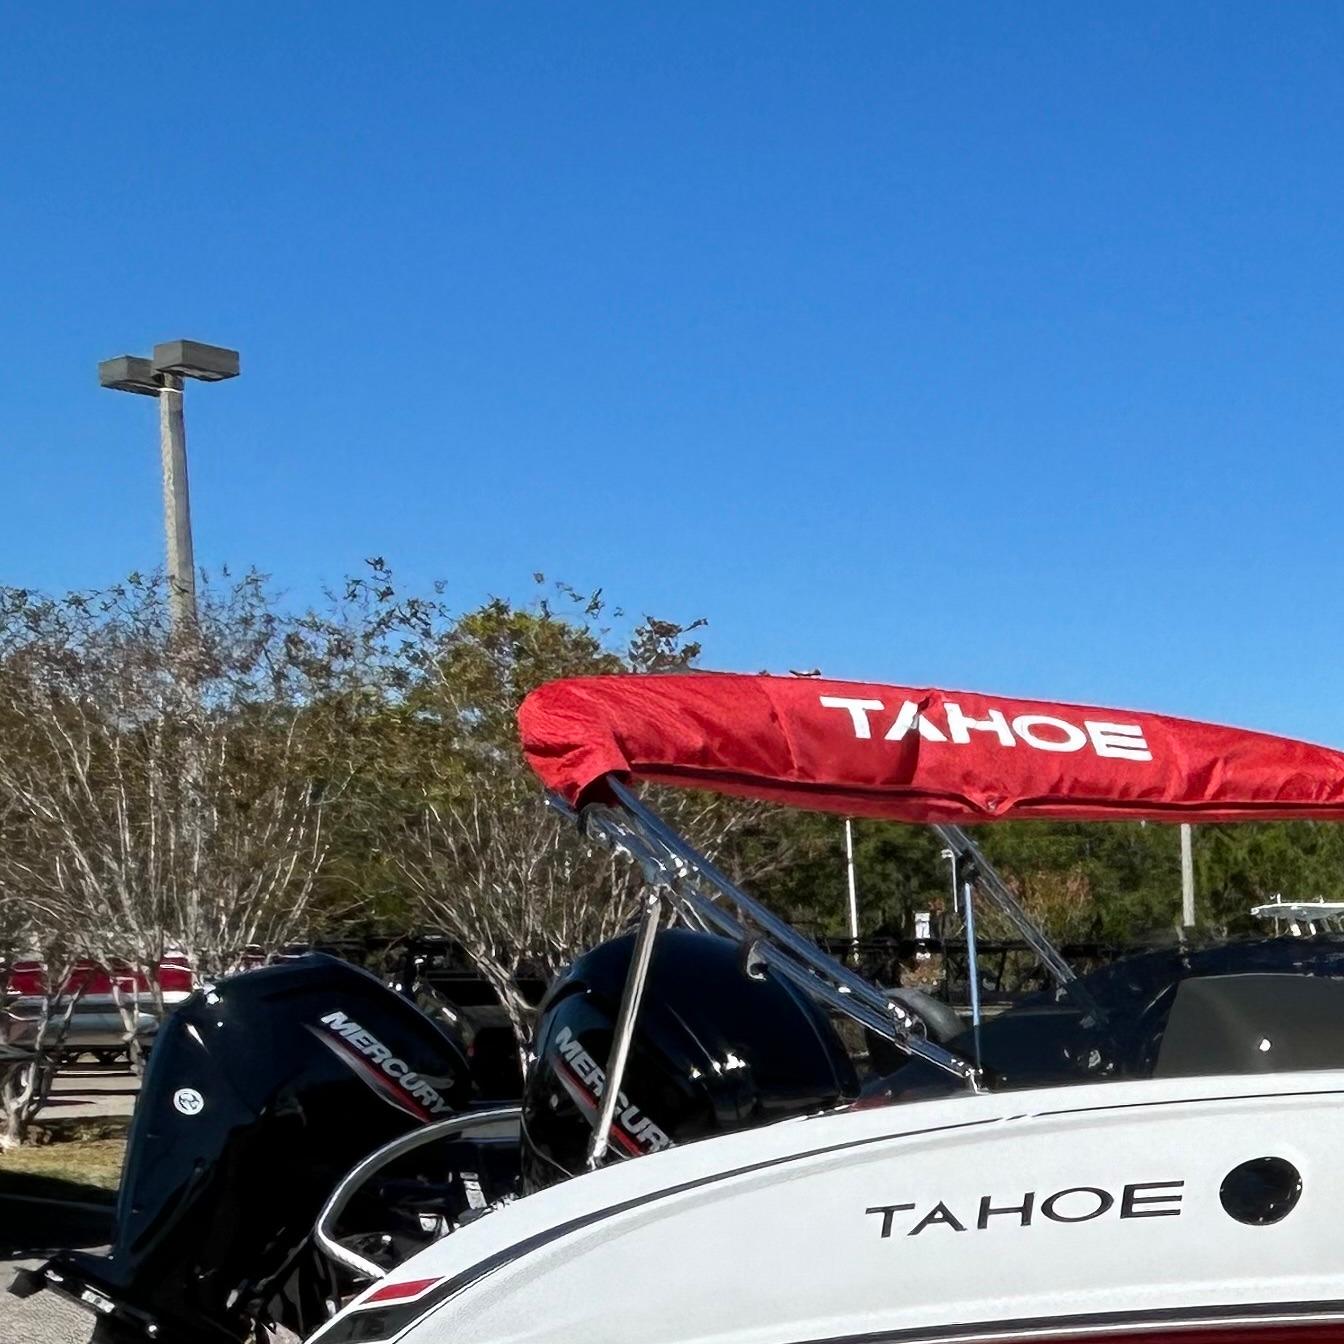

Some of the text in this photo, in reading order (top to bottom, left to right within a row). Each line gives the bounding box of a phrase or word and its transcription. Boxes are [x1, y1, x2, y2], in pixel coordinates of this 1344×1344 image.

[818, 694, 1153, 763] TAHOE
[320, 1010, 453, 1113] MERCURY
[865, 1180, 1186, 1239] TAHOE
